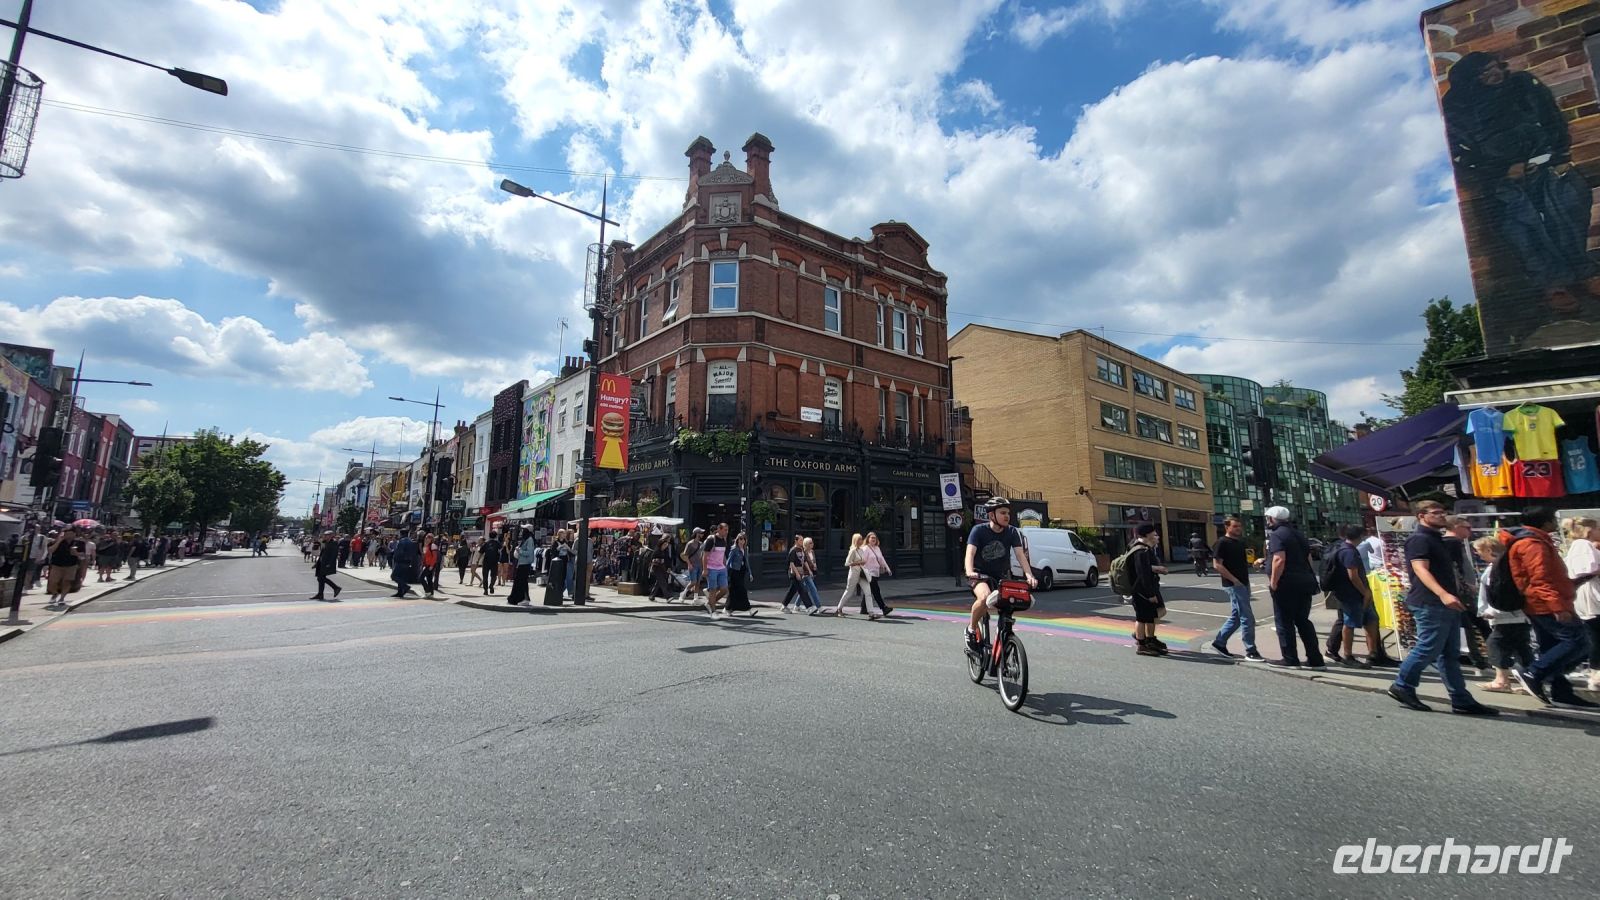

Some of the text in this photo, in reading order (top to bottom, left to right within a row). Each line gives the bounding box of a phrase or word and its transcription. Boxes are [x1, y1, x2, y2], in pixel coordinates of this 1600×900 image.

[600, 393, 629, 405] Hungry?
[629, 462, 652, 473] OXFORD
[653, 458, 670, 470] ARMS
[770, 457, 857, 473] THE OXFORD ARMS
[1522, 463, 1552, 477] 23
[1371, 497, 1383, 506] 20
[949, 516, 960, 525] 20
